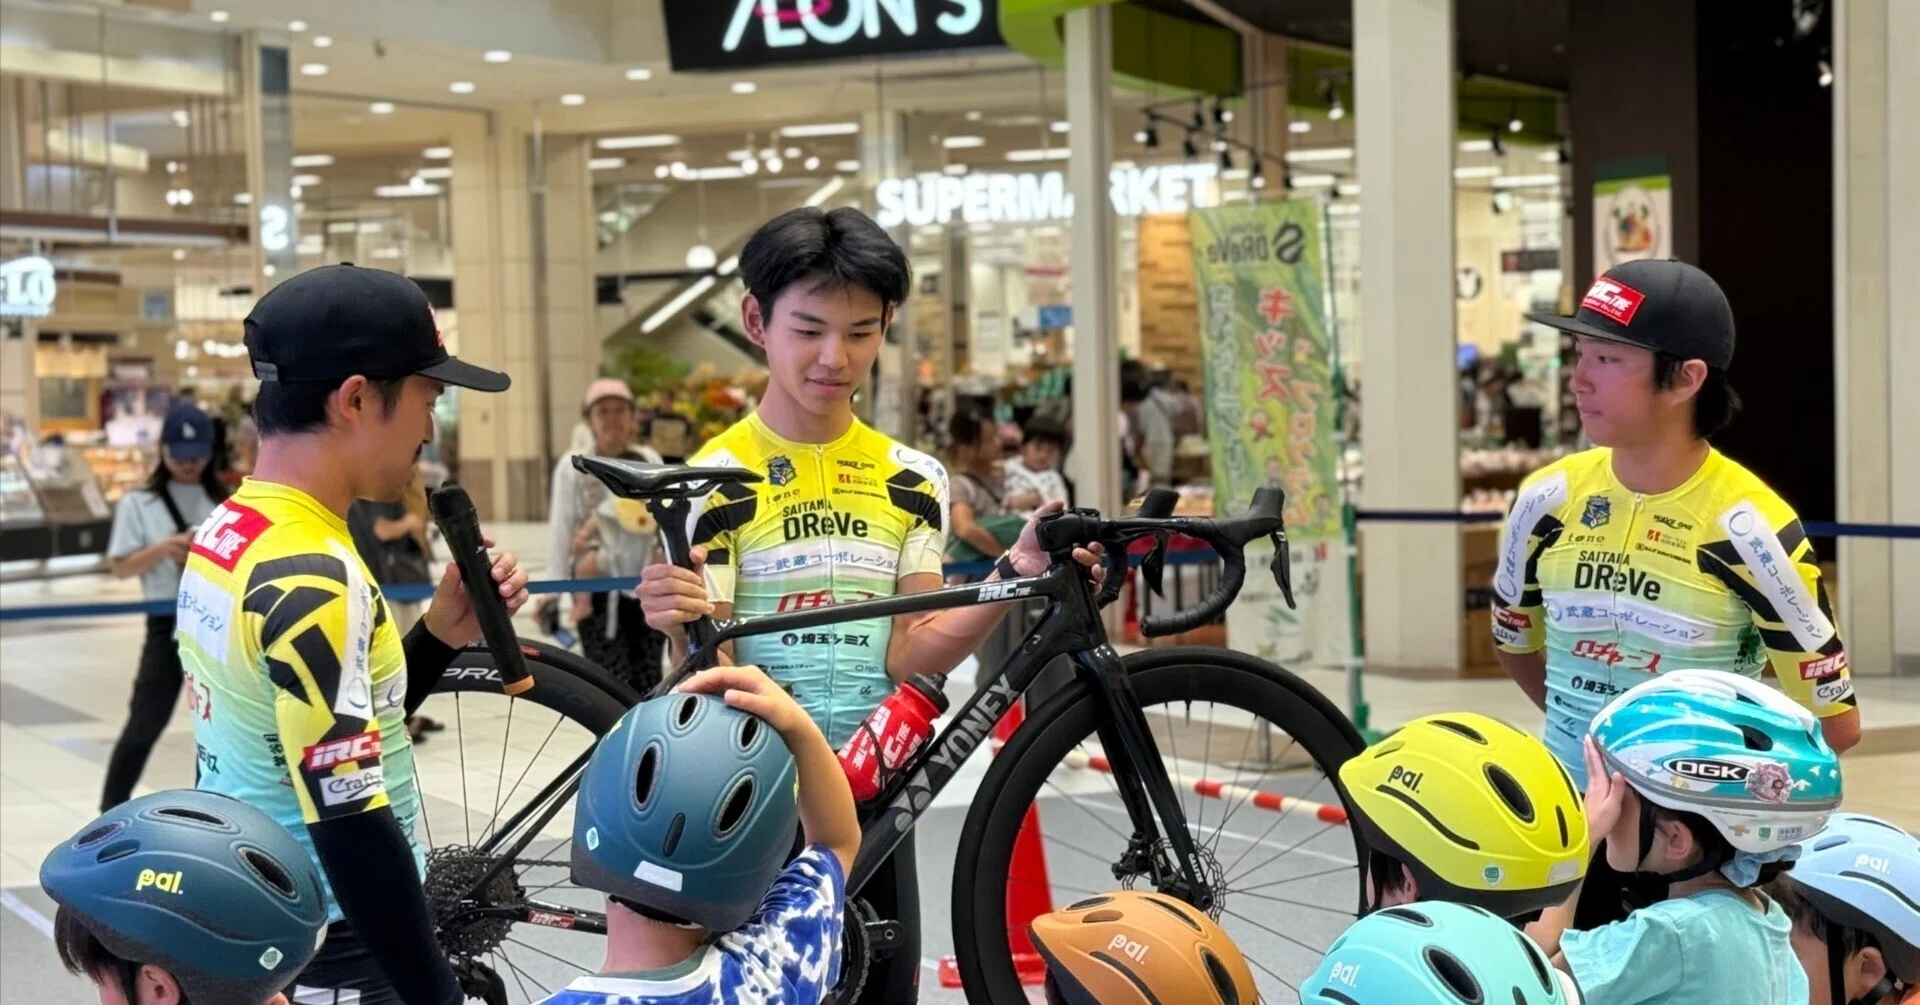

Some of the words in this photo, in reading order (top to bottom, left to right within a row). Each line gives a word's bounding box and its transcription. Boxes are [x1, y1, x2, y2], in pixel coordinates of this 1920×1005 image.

[876, 163, 1218, 226] SUPERMRKET
[783, 512, 868, 541] DReVe
[1574, 562, 1661, 602] DReVe
[1749, 536, 1822, 639] 武蔵コーポレーション
[1565, 605, 1705, 639] 武蔵コーポレーション
[1676, 760, 1742, 779] OGK
